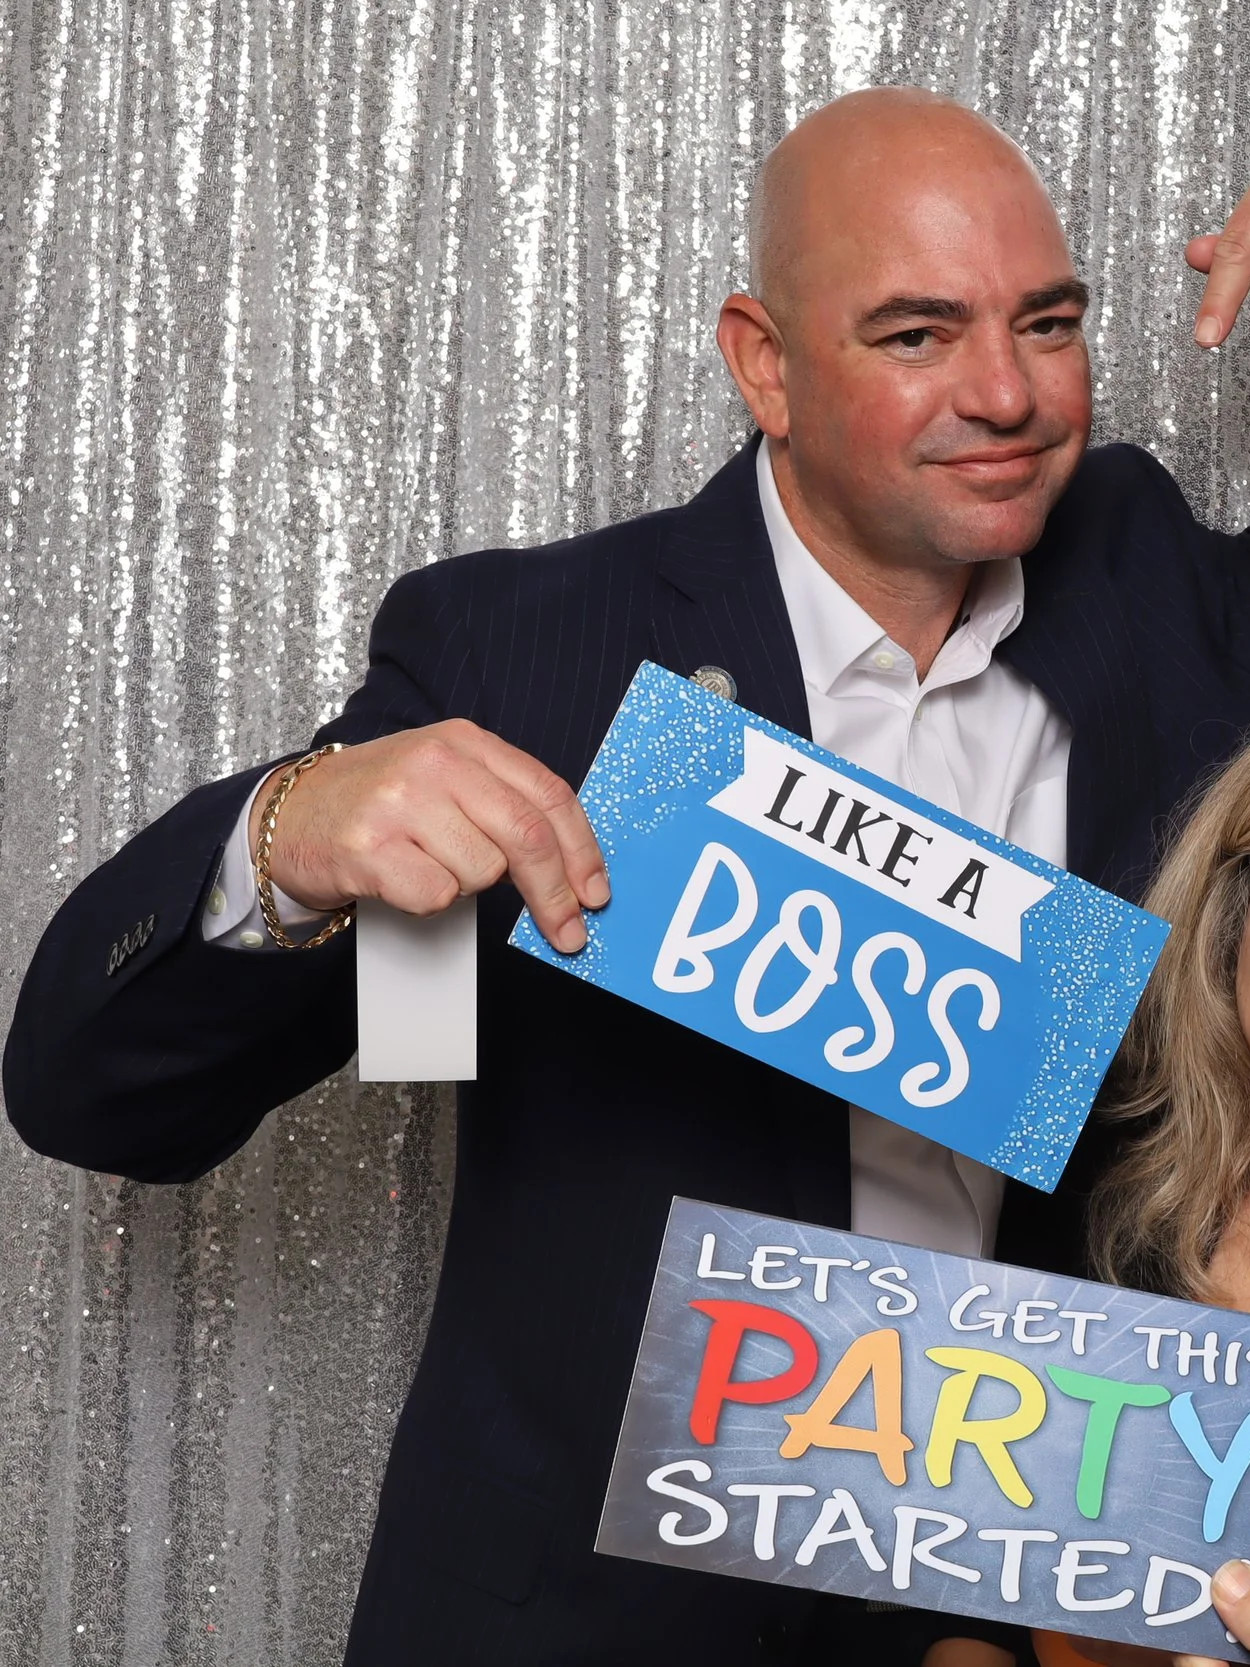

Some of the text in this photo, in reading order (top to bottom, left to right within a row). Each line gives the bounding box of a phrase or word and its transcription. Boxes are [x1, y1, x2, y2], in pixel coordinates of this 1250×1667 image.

[763, 764, 990, 920] LIKE A
[651, 841, 1001, 1108] BOSS
[696, 1233, 918, 1316] LET'S
[949, 1285, 1108, 1356] GET
